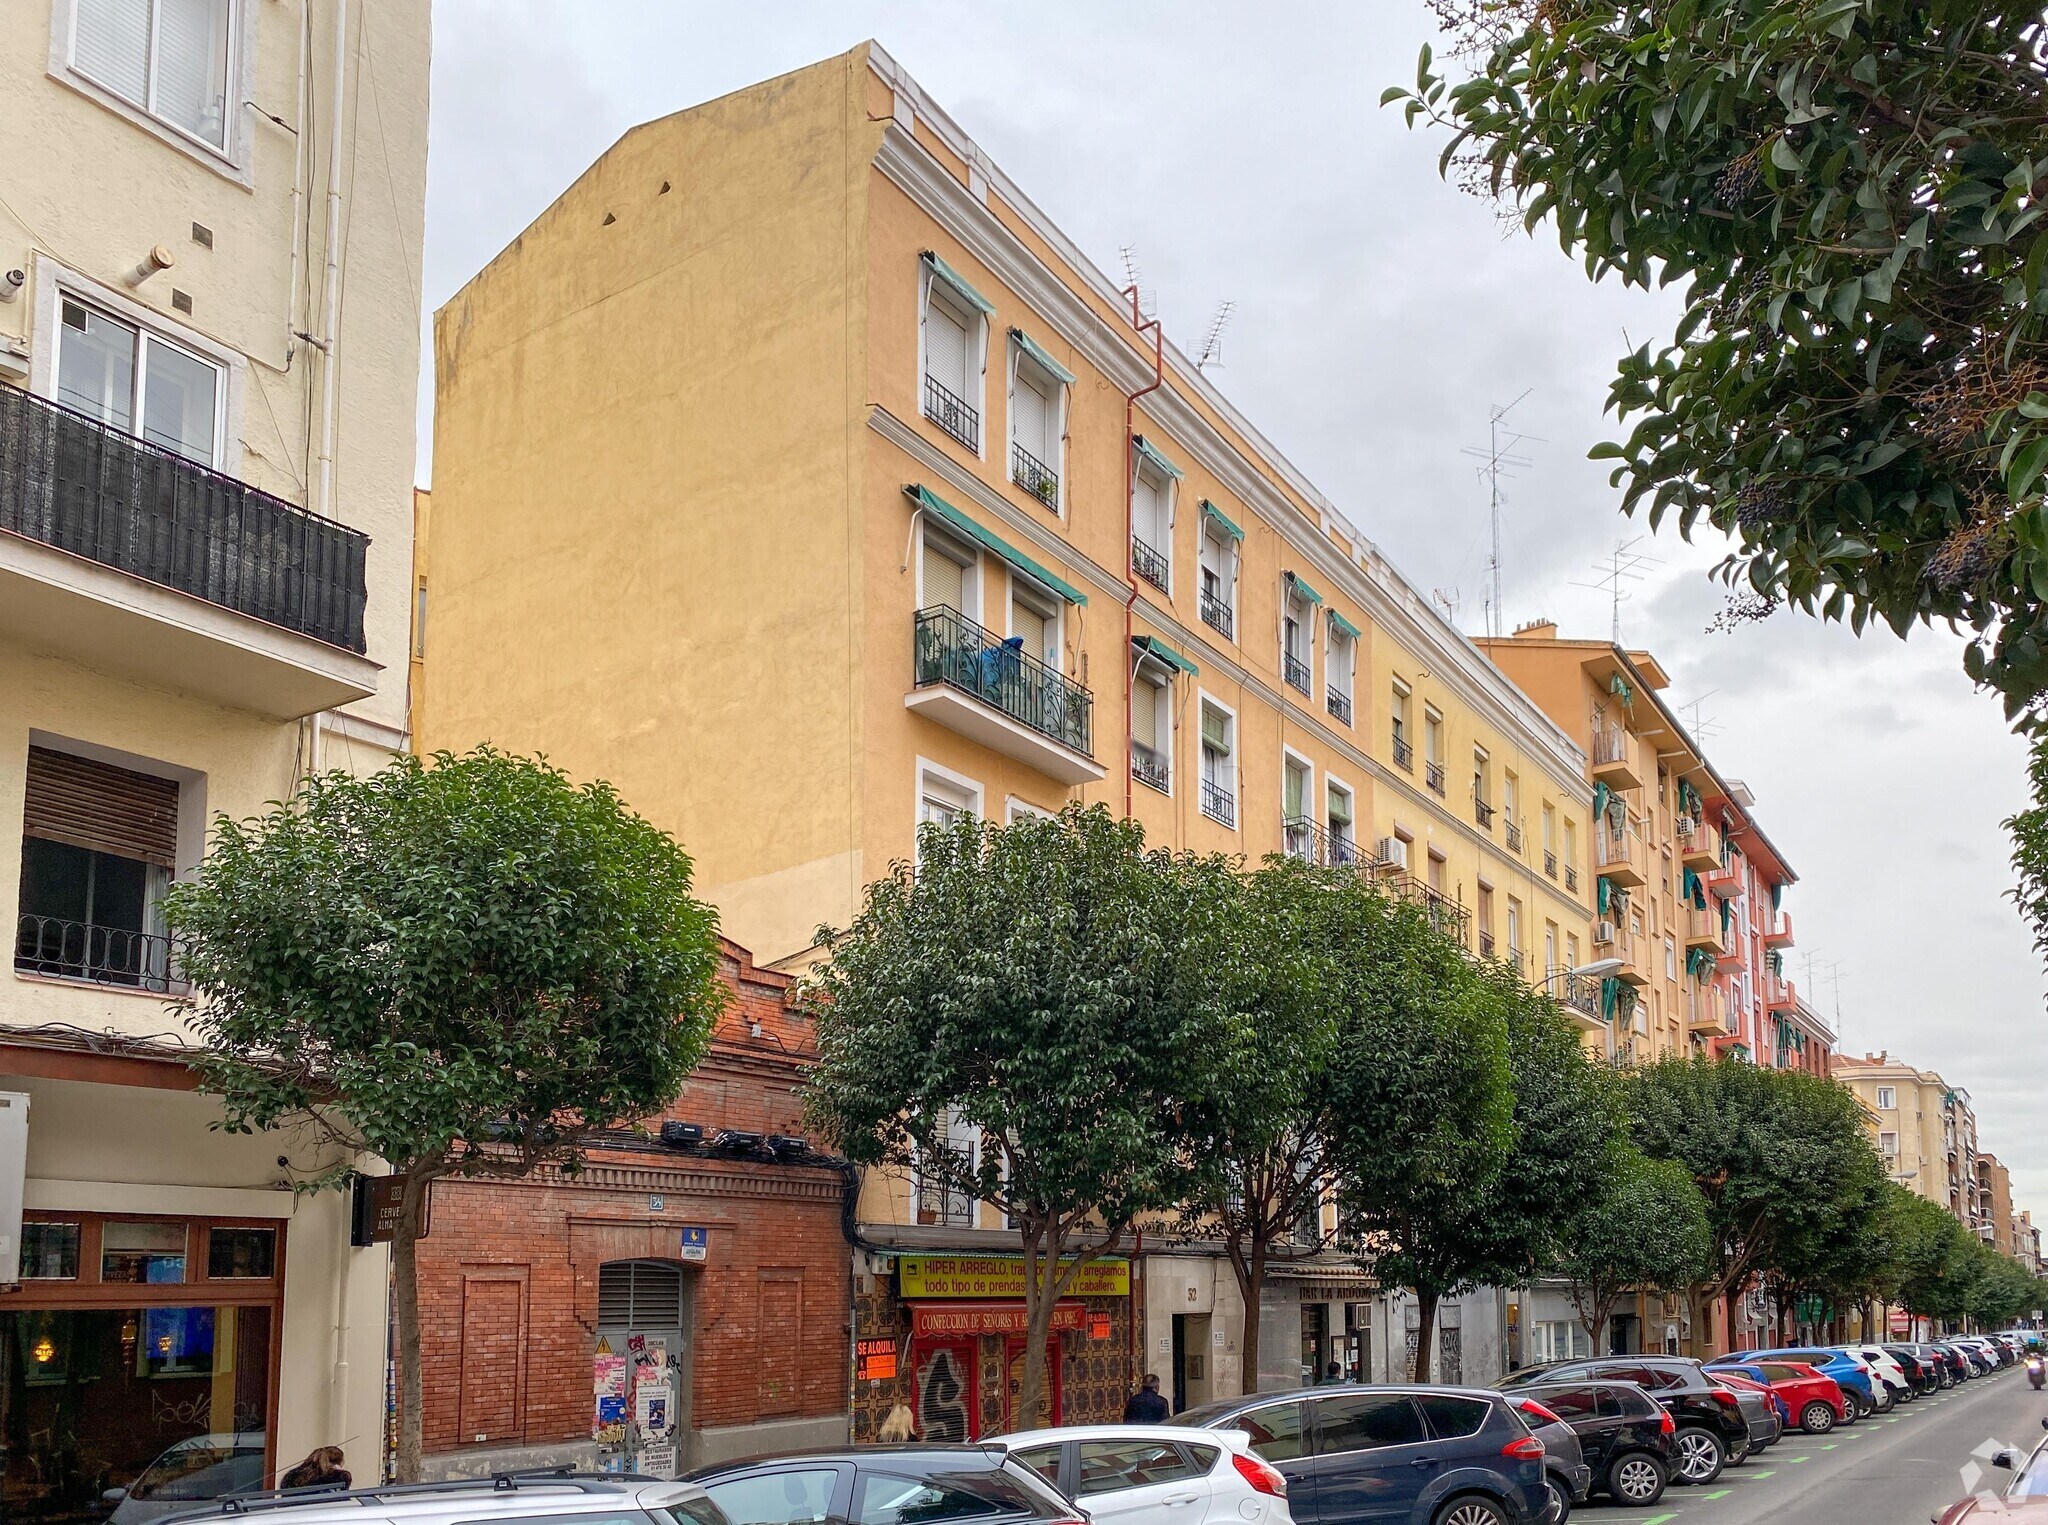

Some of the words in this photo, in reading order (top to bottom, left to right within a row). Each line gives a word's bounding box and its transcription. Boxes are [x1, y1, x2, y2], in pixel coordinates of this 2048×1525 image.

[380, 1206, 401, 1219] CERVE
[378, 1219, 393, 1231] ALHA
[924, 1260, 956, 1275] HIPER
[960, 1261, 1009, 1277] ARREGLO,
[1084, 1265, 1127, 1278] arreglamos
[924, 1279, 949, 1292] todo
[952, 1279, 971, 1294] tipo
[974, 1279, 986, 1292] de
[989, 1279, 1025, 1294] prendas
[1080, 1281, 1117, 1292] caballero.
[921, 1314, 969, 1330] CONFECCION
[971, 1313, 981, 1329] DE
[983, 1310, 1012, 1328] SEÑORAS
[1013, 1313, 1019, 1328] Y
[858, 1341, 867, 1355] SE
[867, 1340, 897, 1355] ALQUILA
